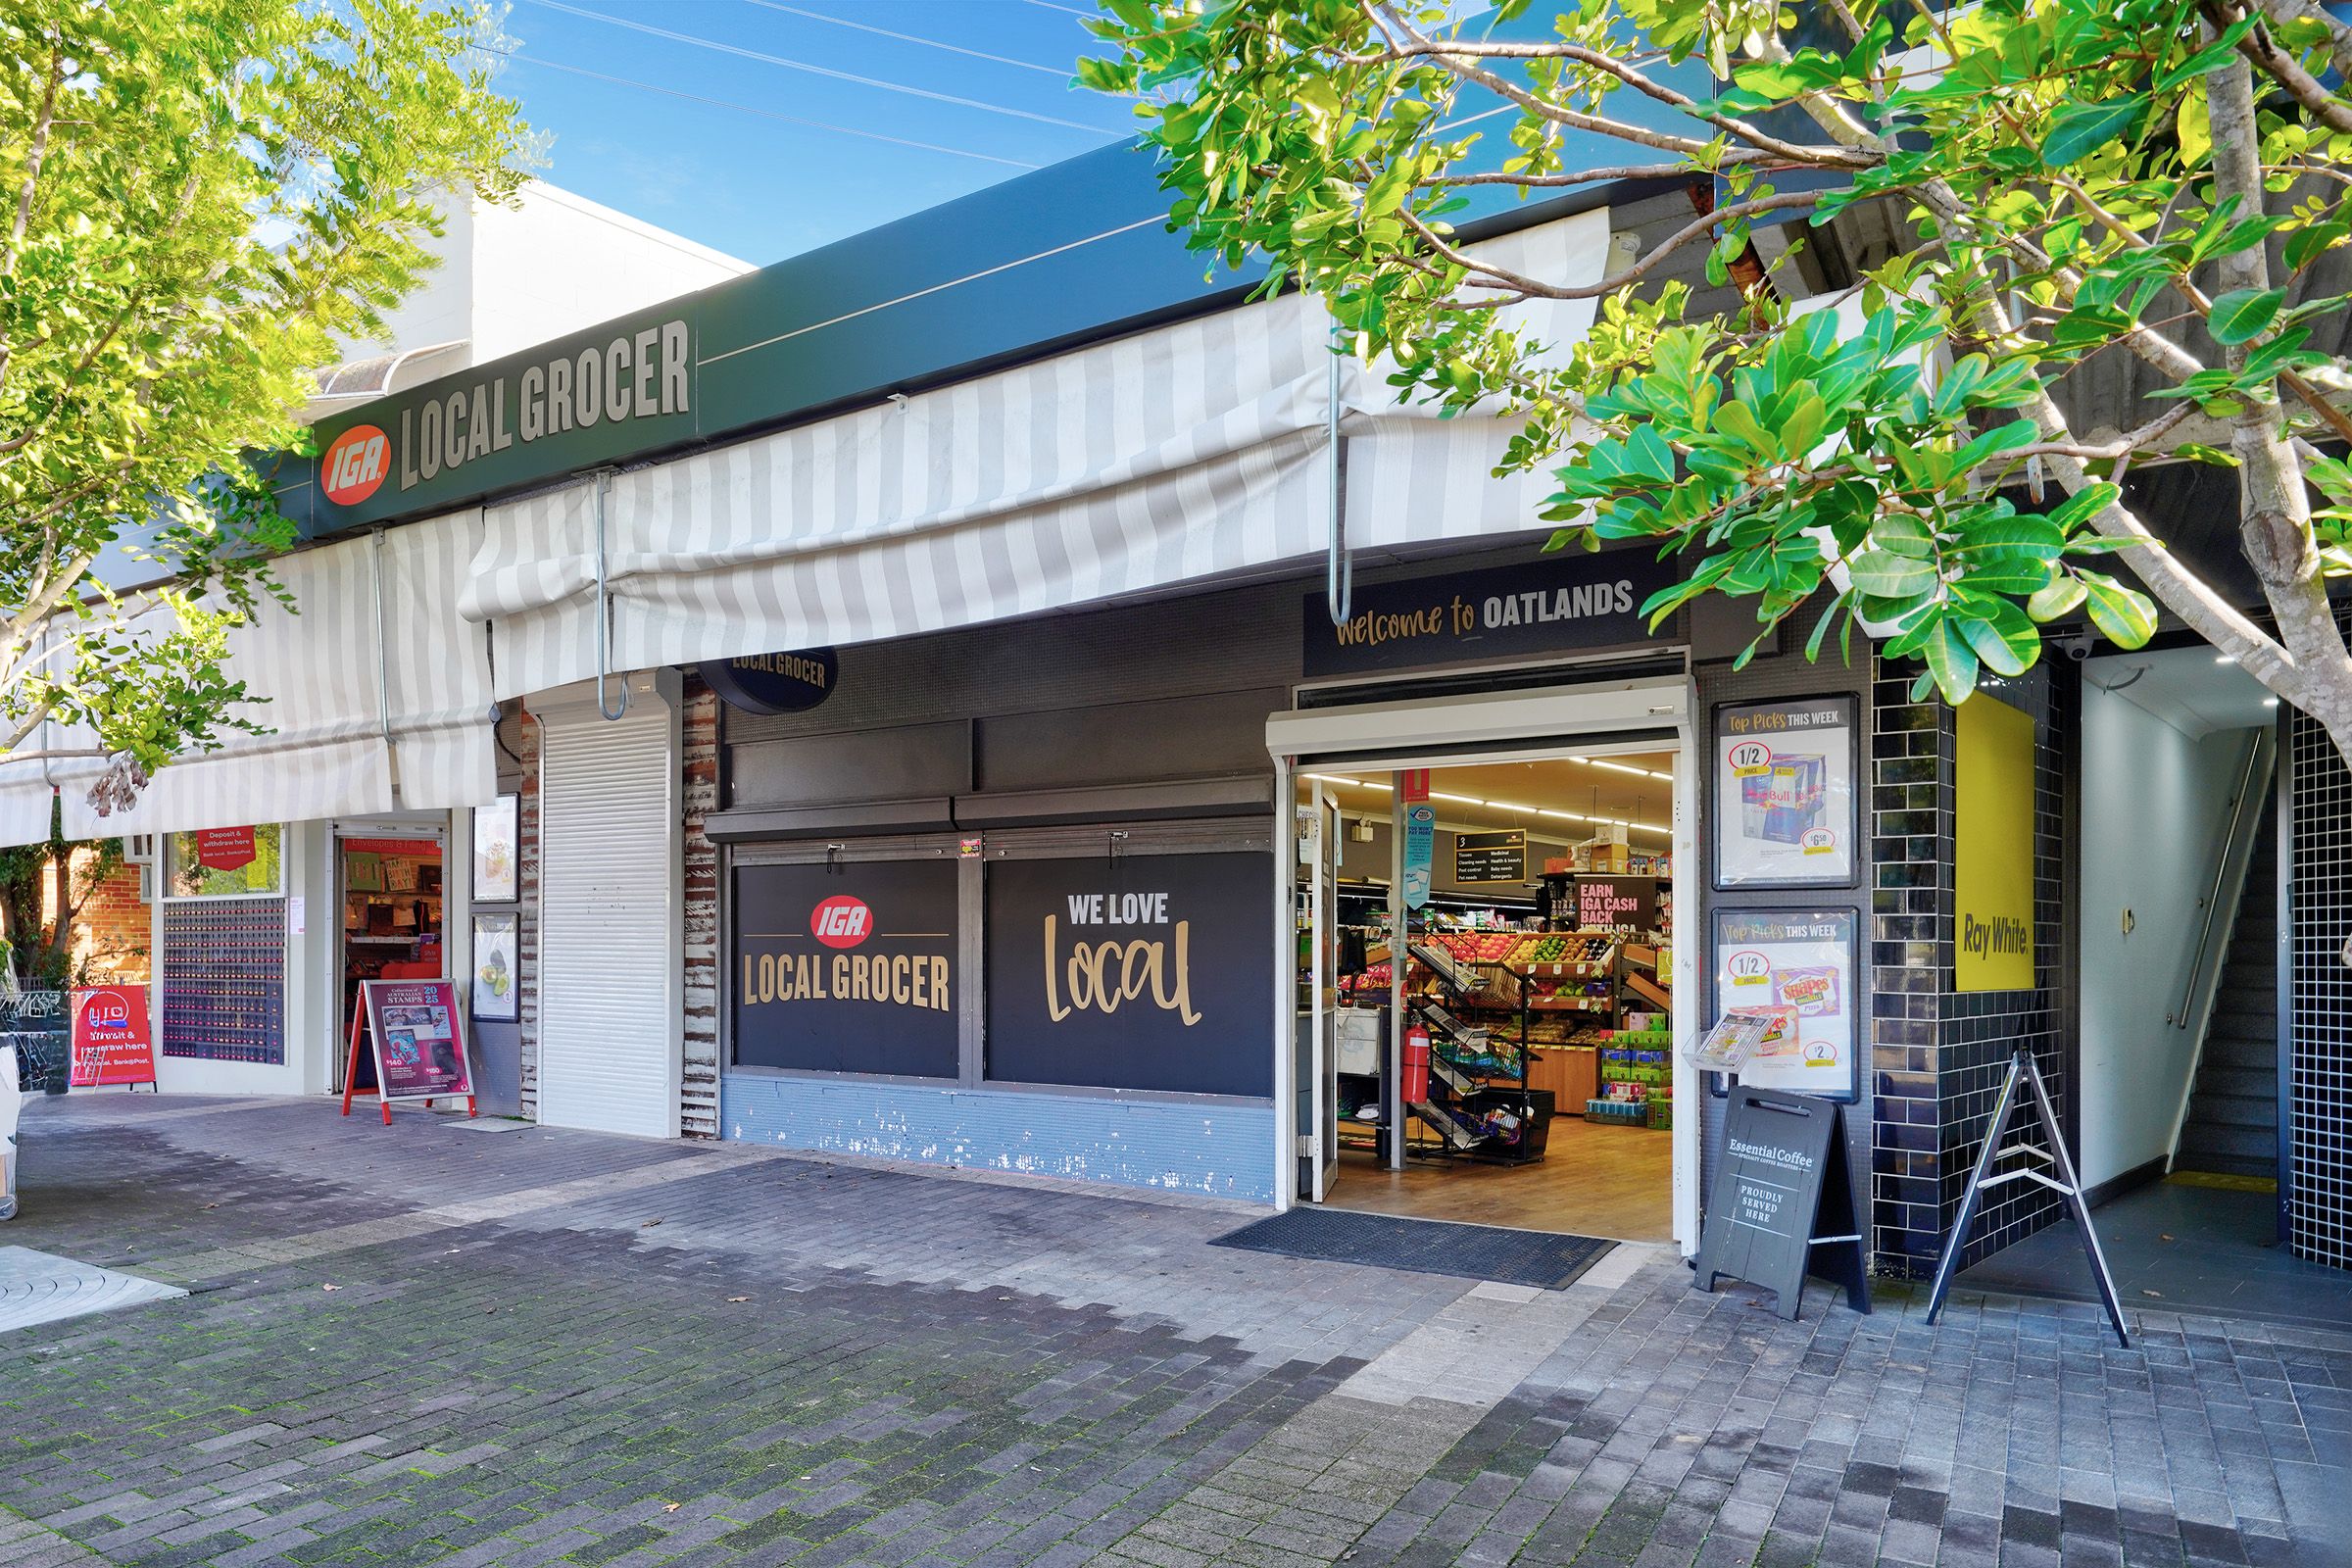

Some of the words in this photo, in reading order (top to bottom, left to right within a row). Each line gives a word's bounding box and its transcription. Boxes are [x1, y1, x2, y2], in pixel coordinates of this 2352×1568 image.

[401, 377, 512, 491] LOCAL
[520, 319, 689, 442] GROCER
[327, 435, 384, 492] IGA
[1450, 595, 1475, 636] to
[1483, 579, 1633, 628] OATLANDS
[732, 653, 775, 673] LOCAL
[775, 653, 825, 688] GROCER
[1729, 715, 1749, 732] Top
[1788, 713, 1809, 726] THIS
[1811, 710, 1838, 724] WEEK
[1740, 747, 1759, 765] 1/2
[1459, 837, 1466, 848] 3
[1581, 884, 1613, 897] EARN
[1067, 894, 1103, 924] WE
[1108, 893, 1168, 924] LOVE
[1581, 898, 1601, 910] IGA
[1604, 898, 1638, 910] CASH
[817, 906, 867, 936] IGA
[1581, 910, 1613, 923] BACK
[1786, 925, 1808, 938] THIS
[1809, 924, 1837, 937] WEEK
[1964, 913, 1990, 960] Ray
[1045, 914, 1202, 1026] Local
[1739, 956, 1758, 974] 1/2
[424, 986, 437, 995] 20
[744, 954, 826, 1005] LOCAL
[832, 954, 949, 1012] GROCER
[425, 995, 439, 1004] 25
[1777, 1149, 1813, 1167] Coffee
[1740, 1185, 1784, 1203] PROUDLY
[1741, 1197, 1778, 1213] SERVED
[1745, 1208, 1771, 1223] HERE
